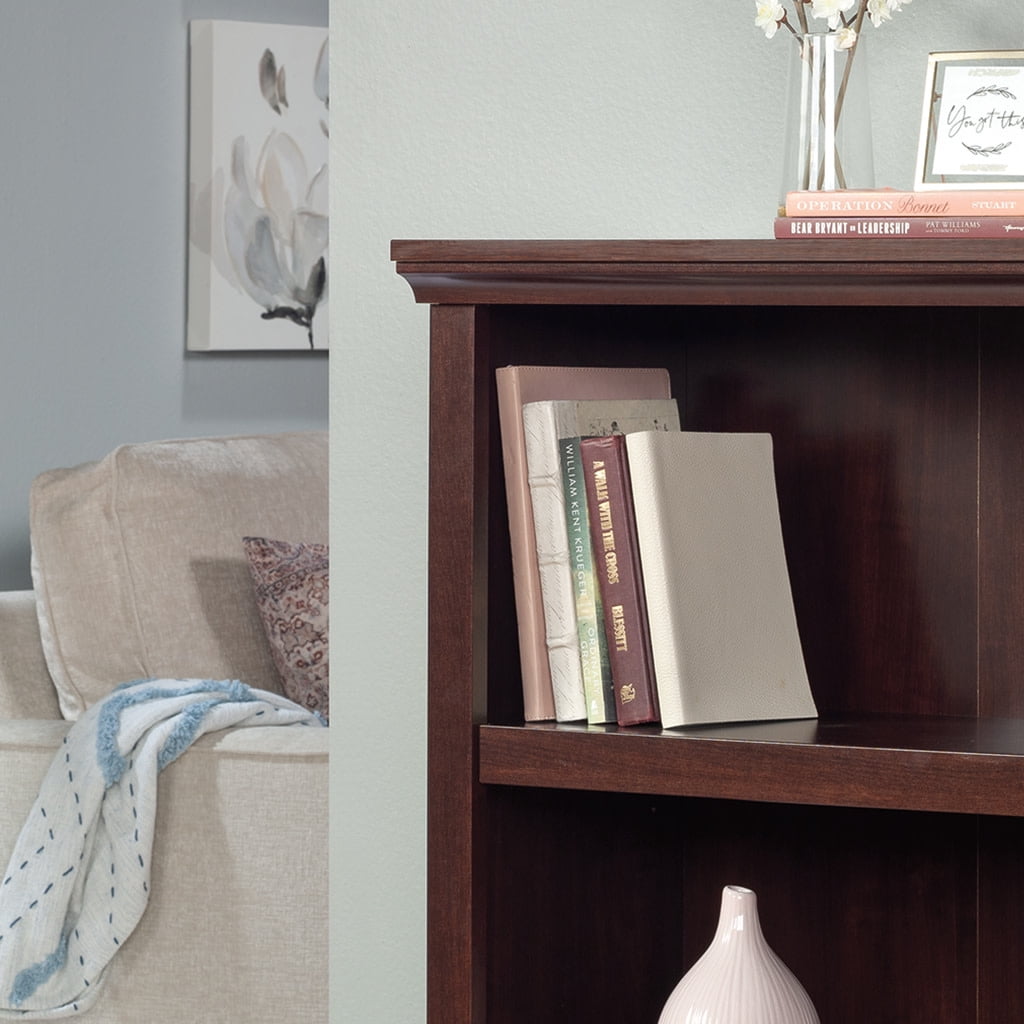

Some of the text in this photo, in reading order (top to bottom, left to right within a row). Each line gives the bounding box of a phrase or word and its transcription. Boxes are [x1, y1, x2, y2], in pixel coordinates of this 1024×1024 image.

[947, 104, 976, 138] You
[976, 108, 1000, 133] got
[796, 195, 951, 214] OPERATION Bonnet
[971, 200, 1016, 210] STUART
[790, 222, 814, 234] BEAR
[815, 222, 847, 234] BRYANT
[857, 222, 910, 234] LEADERSHIP
[925, 221, 940, 229] PAT
[565, 444, 588, 596] WILLIAM KENT KRUEGER
[592, 460, 619, 584] A WALK WITH THE CROSS
[587, 627, 601, 695] ORDINARY
